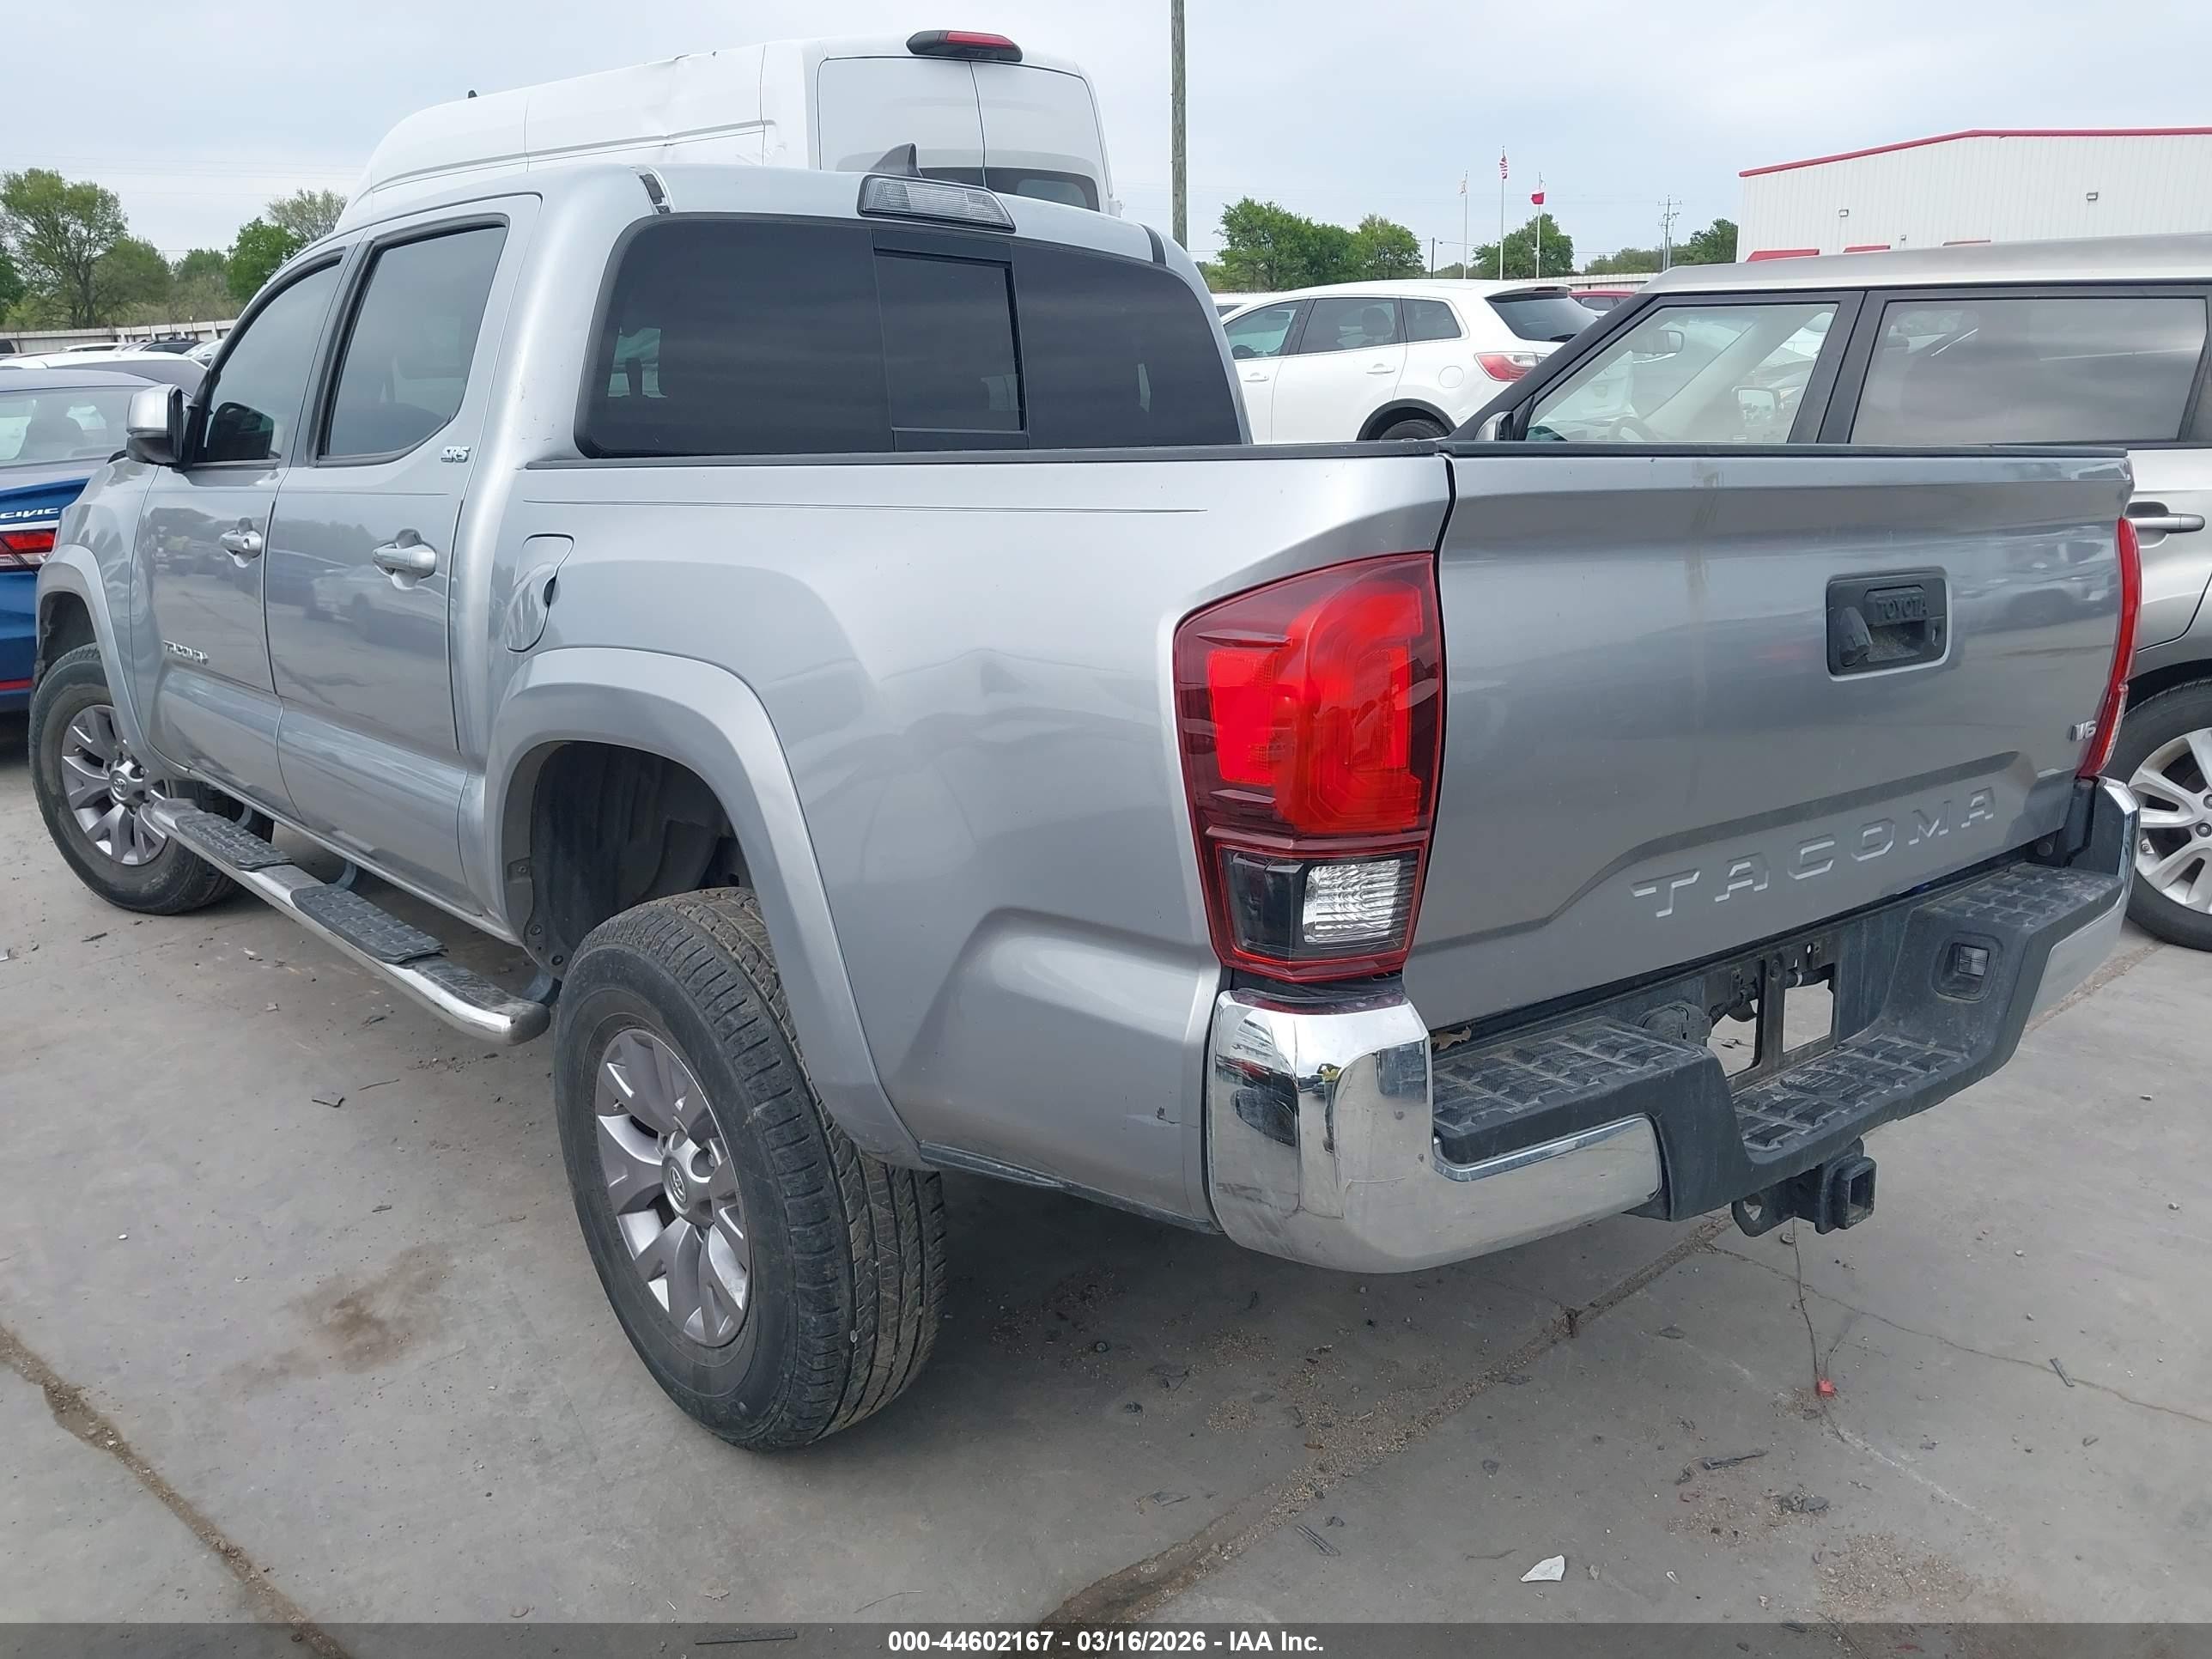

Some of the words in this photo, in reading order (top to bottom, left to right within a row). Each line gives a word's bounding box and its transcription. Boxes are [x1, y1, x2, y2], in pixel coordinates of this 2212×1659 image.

[441, 446, 471, 464] SR5
[0, 507, 58, 519] CIVIC
[1875, 595, 1929, 619] TOYOTA
[2070, 720, 2097, 741] V6
[1631, 786, 1996, 918] TACOMA
